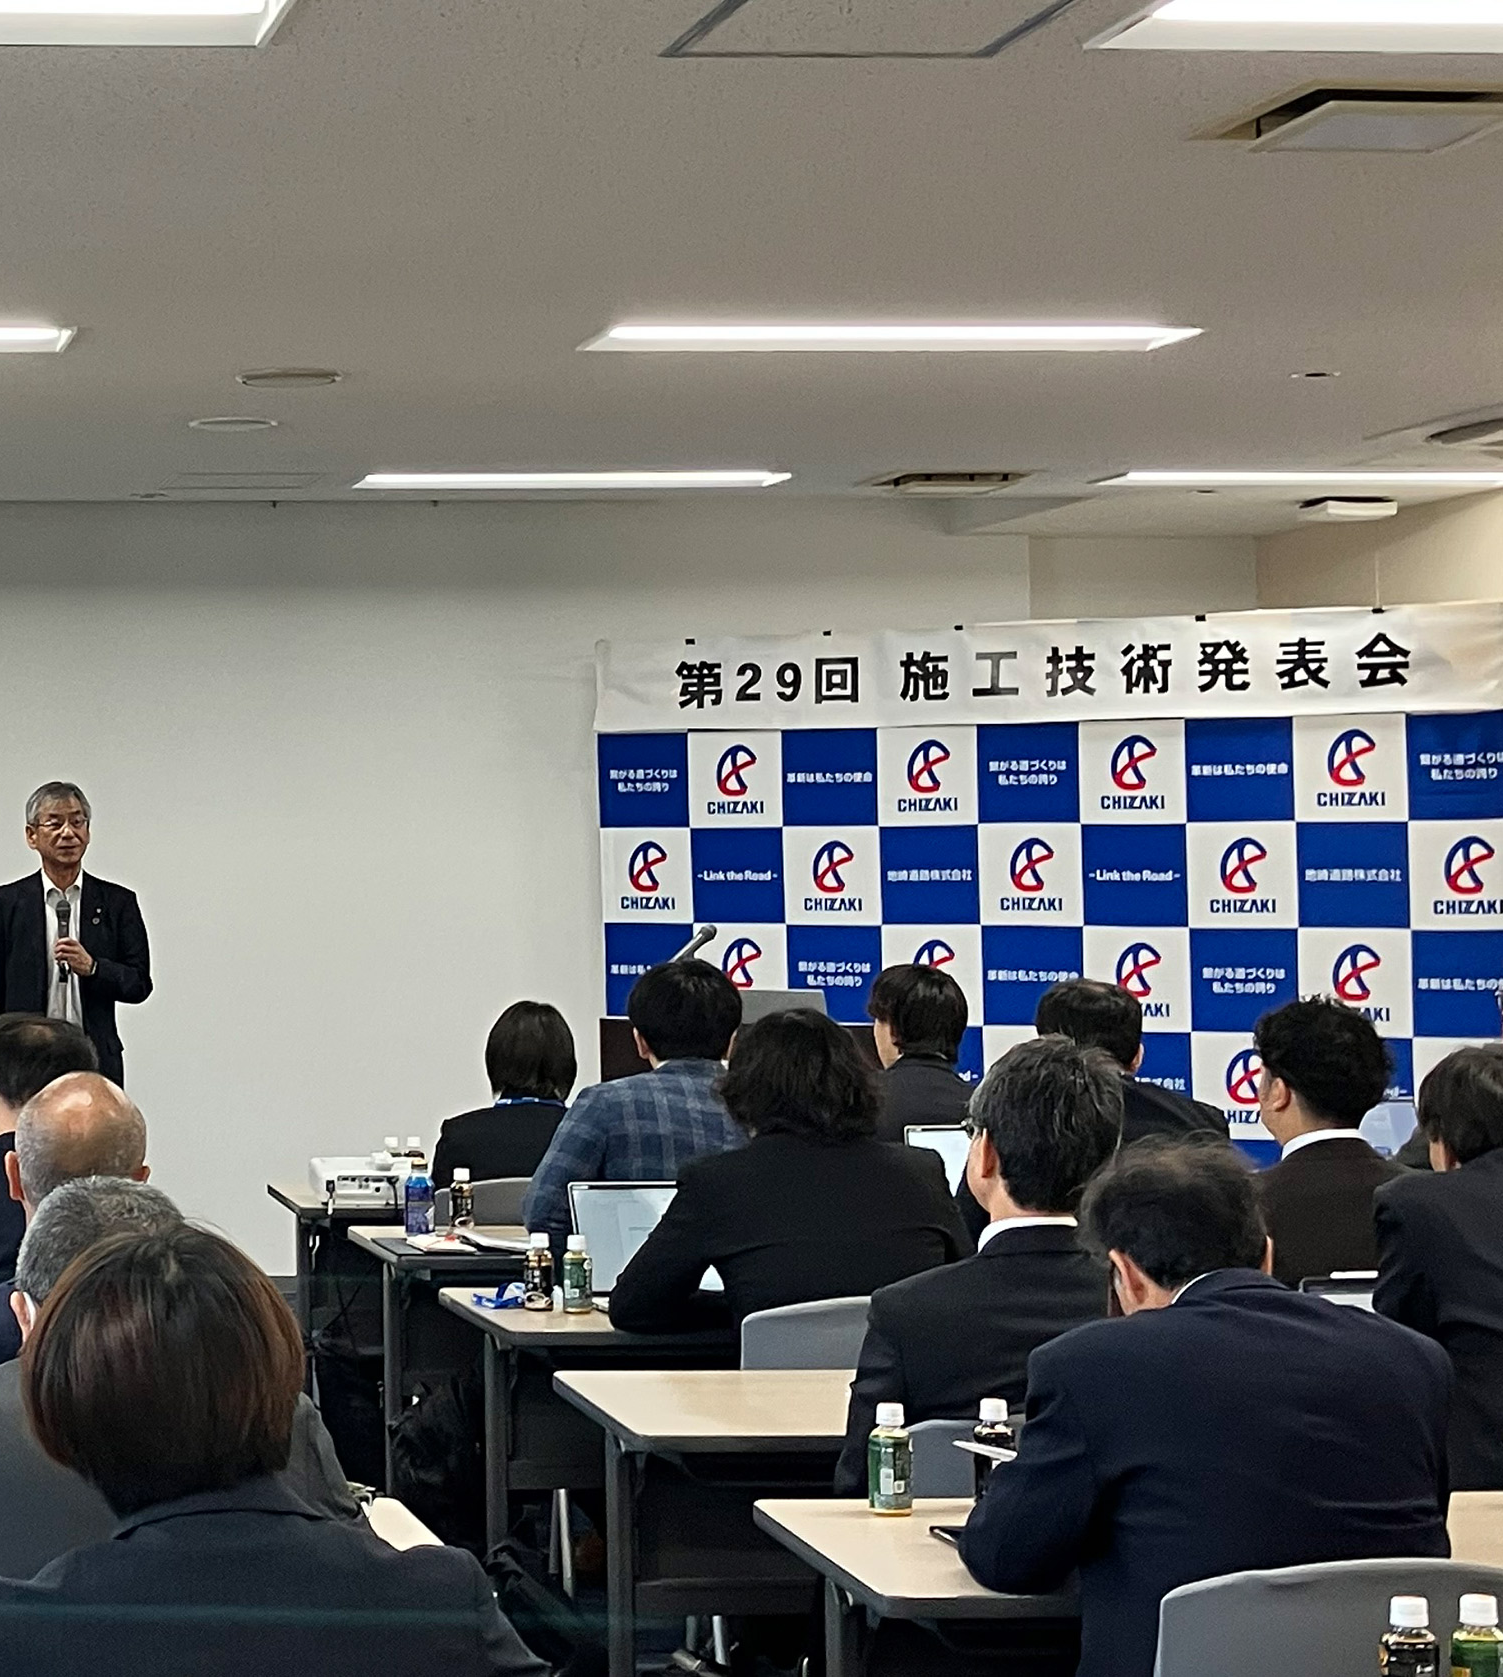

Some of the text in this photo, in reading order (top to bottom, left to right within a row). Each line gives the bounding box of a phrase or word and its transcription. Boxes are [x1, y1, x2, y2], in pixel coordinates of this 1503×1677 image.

[675, 632, 1412, 710] 第29回 施工技術発表会
[898, 797, 958, 812] CHIZAKI
[1100, 795, 1165, 810] CHIZAKI
[1316, 791, 1386, 806] CHIZAKI
[707, 800, 764, 815] CHIZAKI
[726, 870, 744, 881] the
[1122, 870, 1141, 882] the
[620, 897, 676, 910] CHIZAKI
[804, 898, 863, 912] CHIZAKI
[1000, 897, 1063, 911] CHIZAKI
[1210, 898, 1277, 913] CHIZAKI
